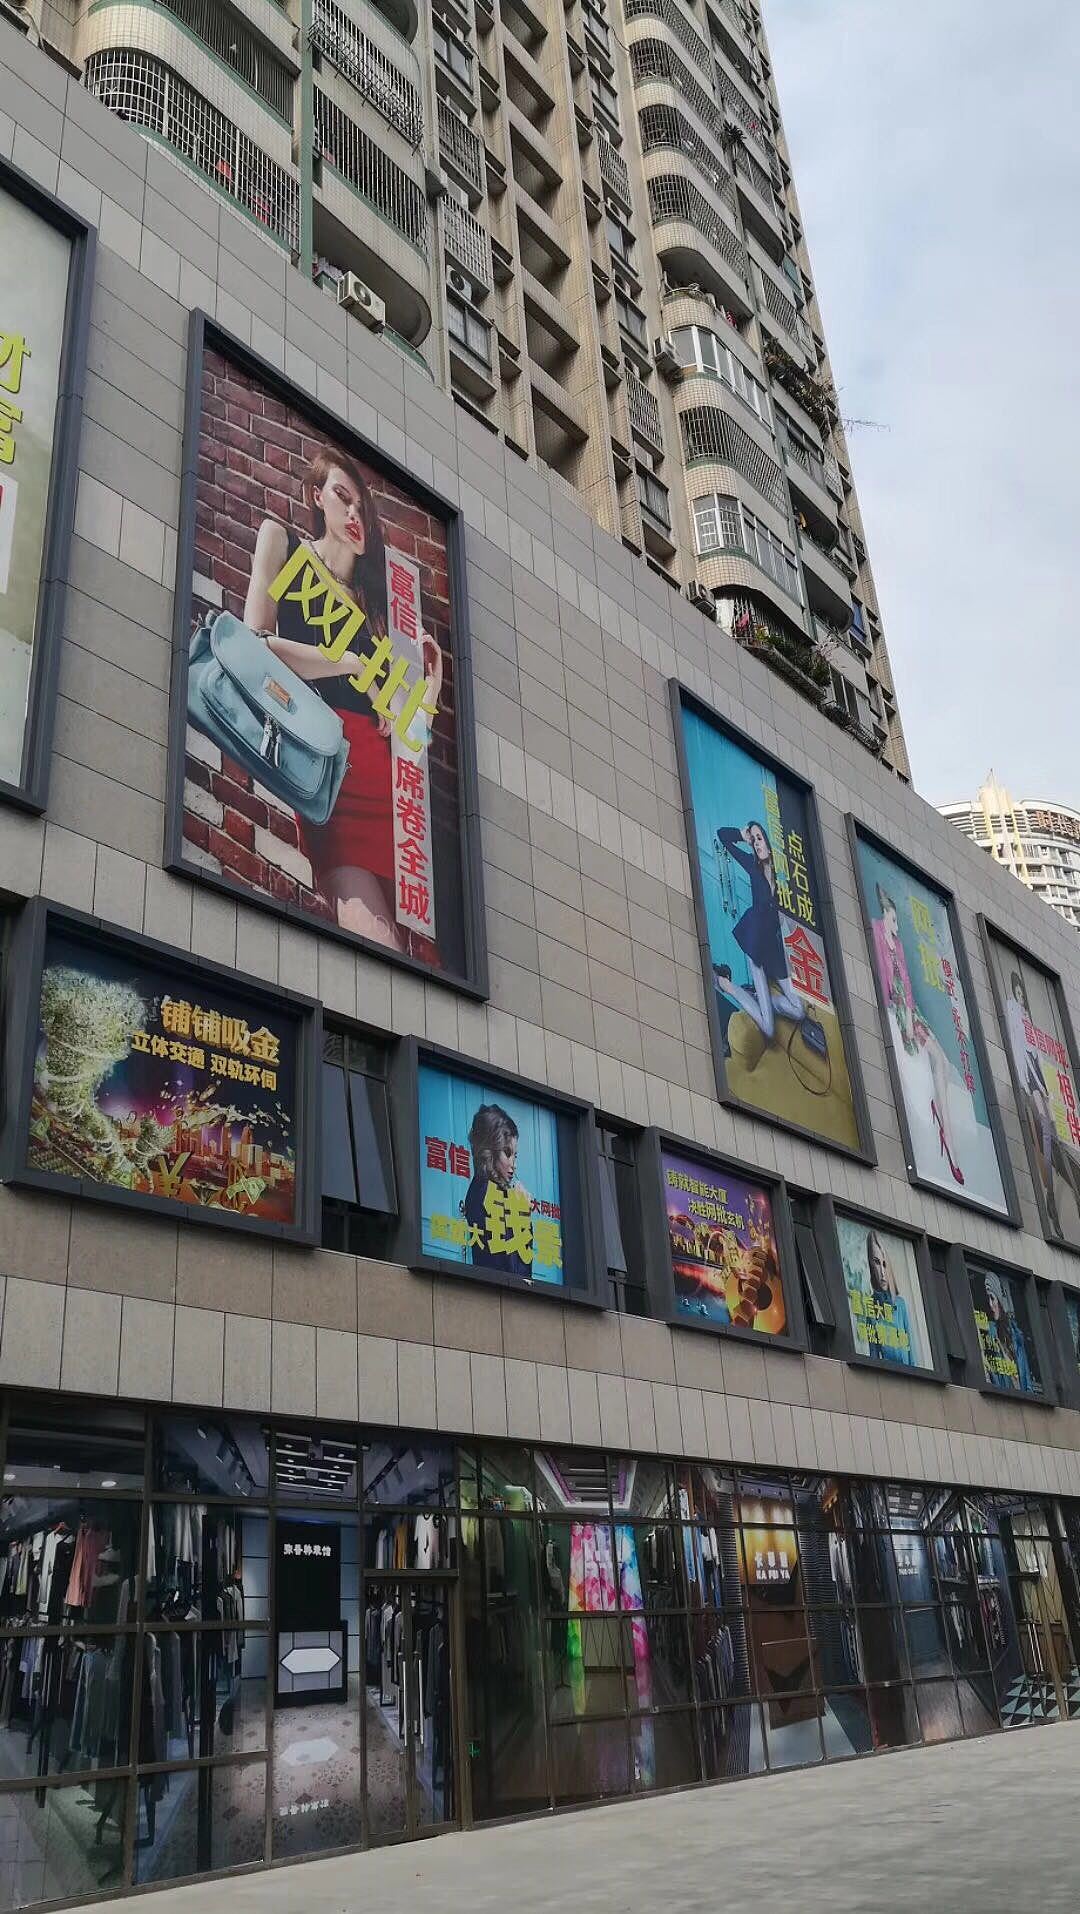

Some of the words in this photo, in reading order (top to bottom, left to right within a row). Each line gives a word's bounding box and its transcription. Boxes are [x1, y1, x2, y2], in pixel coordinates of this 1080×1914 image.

[389, 560, 418, 640] 富信
[268, 544, 439, 752] 网批
[396, 757, 432, 926] 席卷全城
[160, 994, 281, 1067] 铺铺吸金
[425, 1135, 471, 1179] 富信
